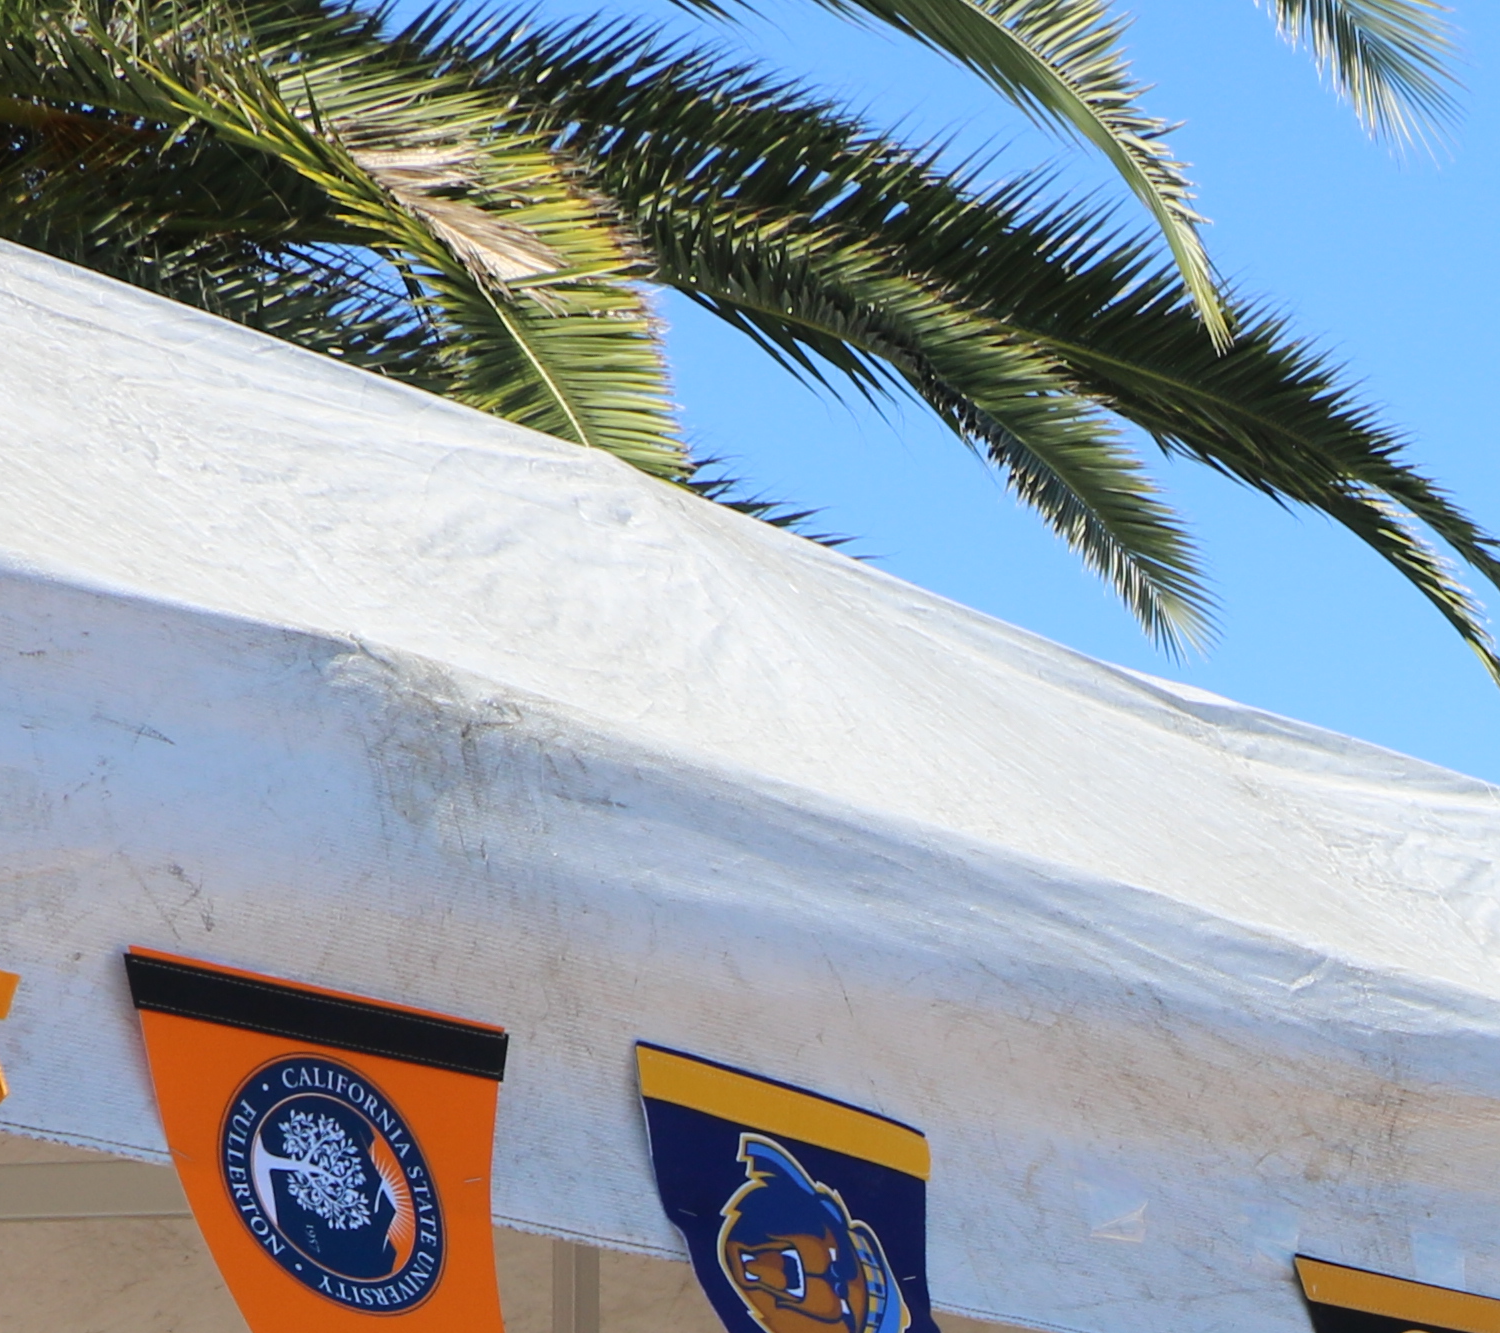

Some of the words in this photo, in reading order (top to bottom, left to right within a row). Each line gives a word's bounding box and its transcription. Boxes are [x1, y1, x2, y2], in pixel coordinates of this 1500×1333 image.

[282, 1067, 410, 1160] CALIFORNIA
[227, 1099, 285, 1257] FULLERTON
[406, 1165, 437, 1248] STATE
[305, 1224, 322, 1254] 1957
[318, 1251, 435, 1306] UNIVERSITY
